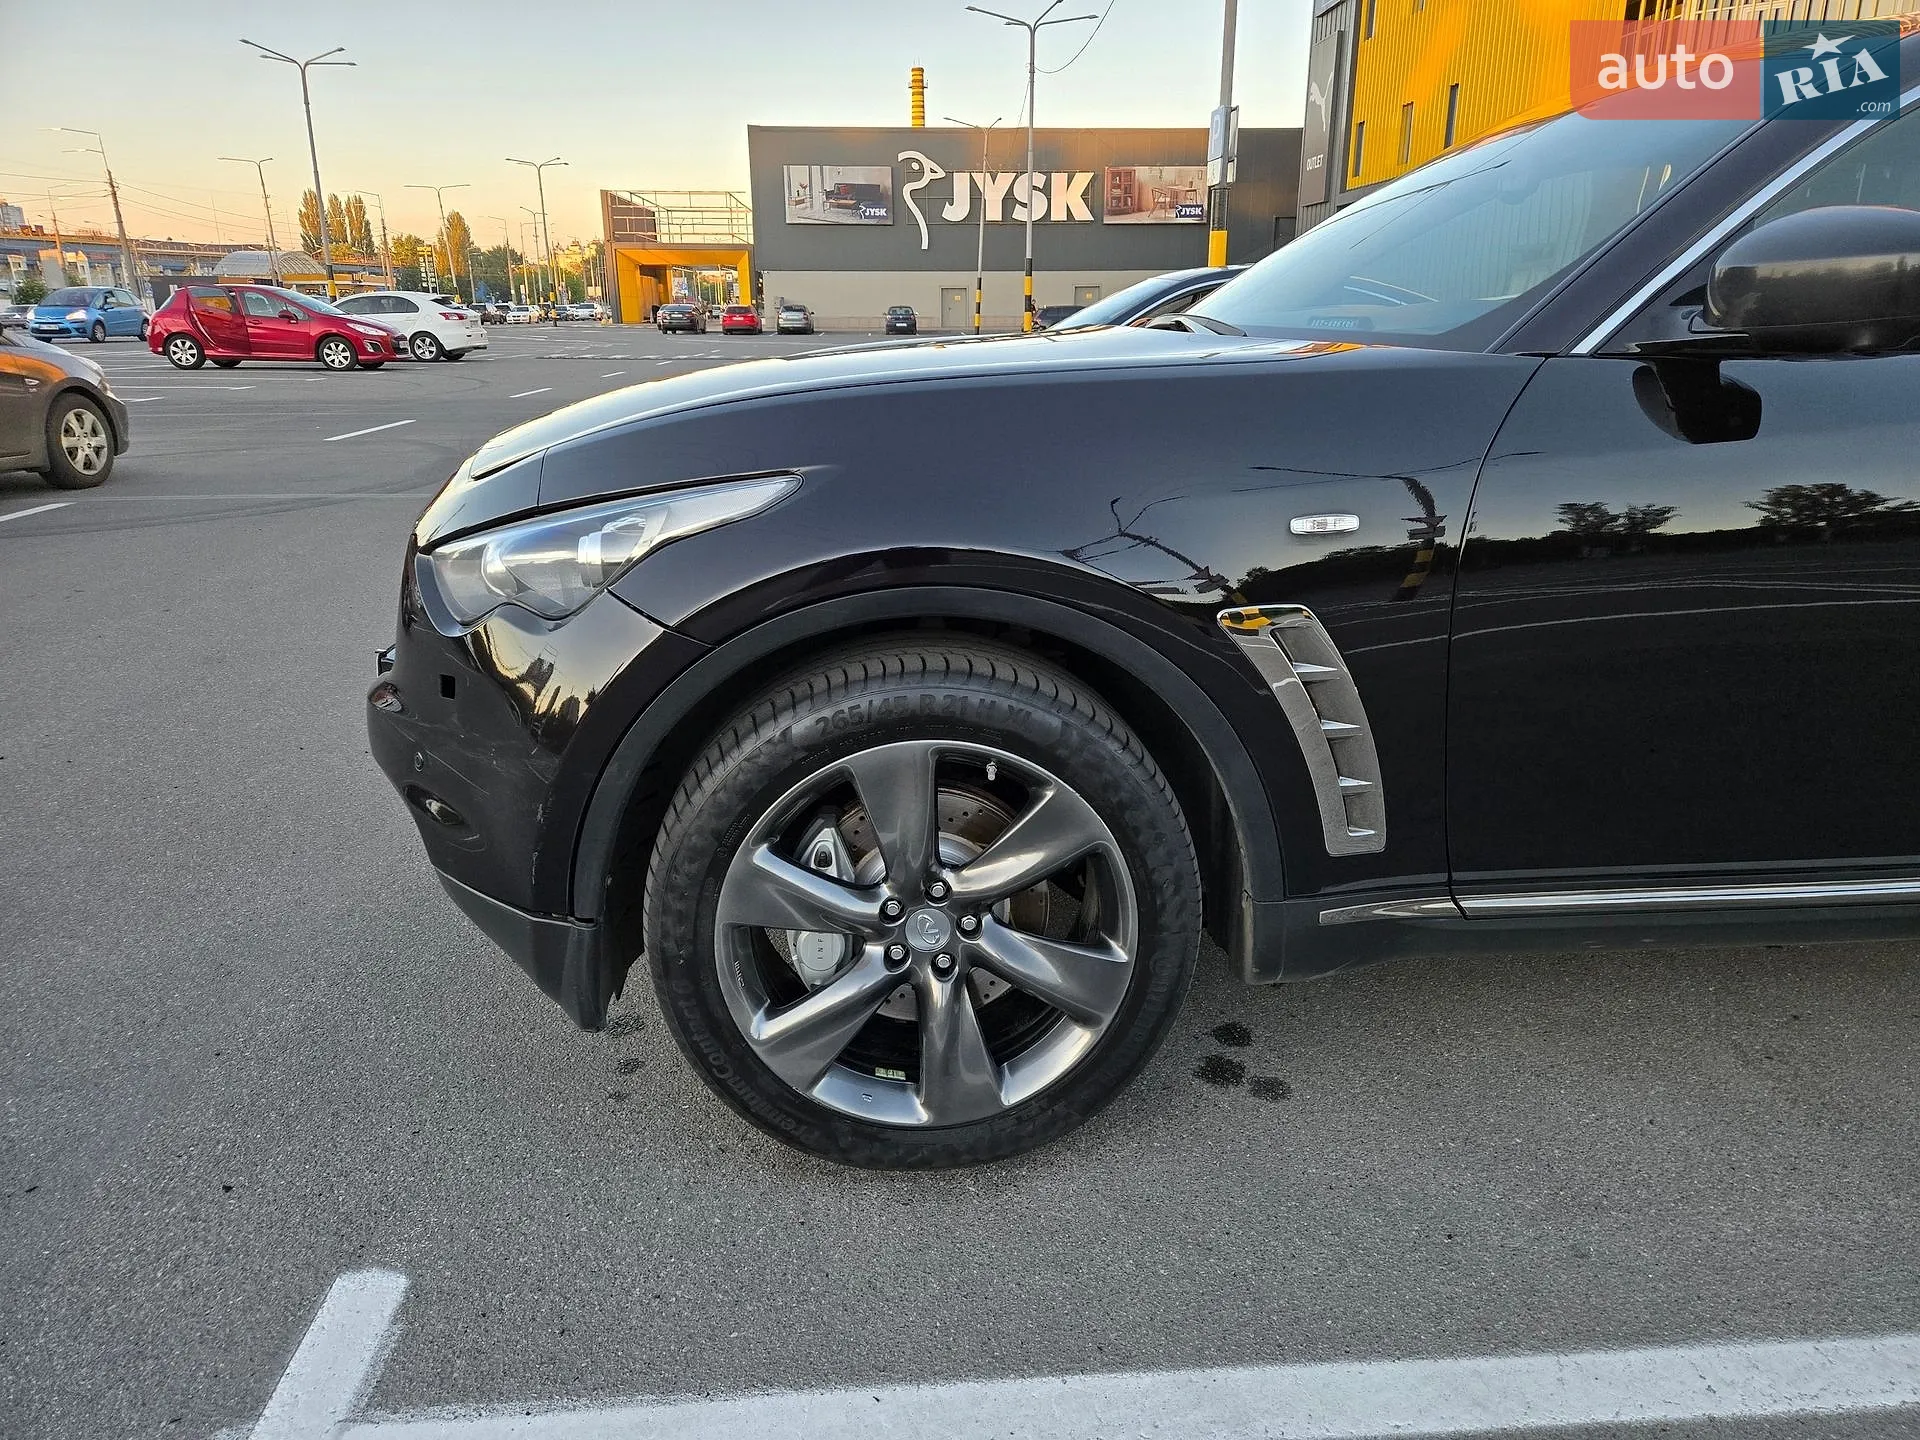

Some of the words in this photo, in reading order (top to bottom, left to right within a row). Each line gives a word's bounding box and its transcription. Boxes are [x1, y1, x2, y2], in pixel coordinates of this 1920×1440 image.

[1306, 154, 1323, 171] OUTLET
[941, 172, 1095, 222] JYSK
[864, 208, 887, 216] JYSK
[1180, 207, 1202, 215] JYSK
